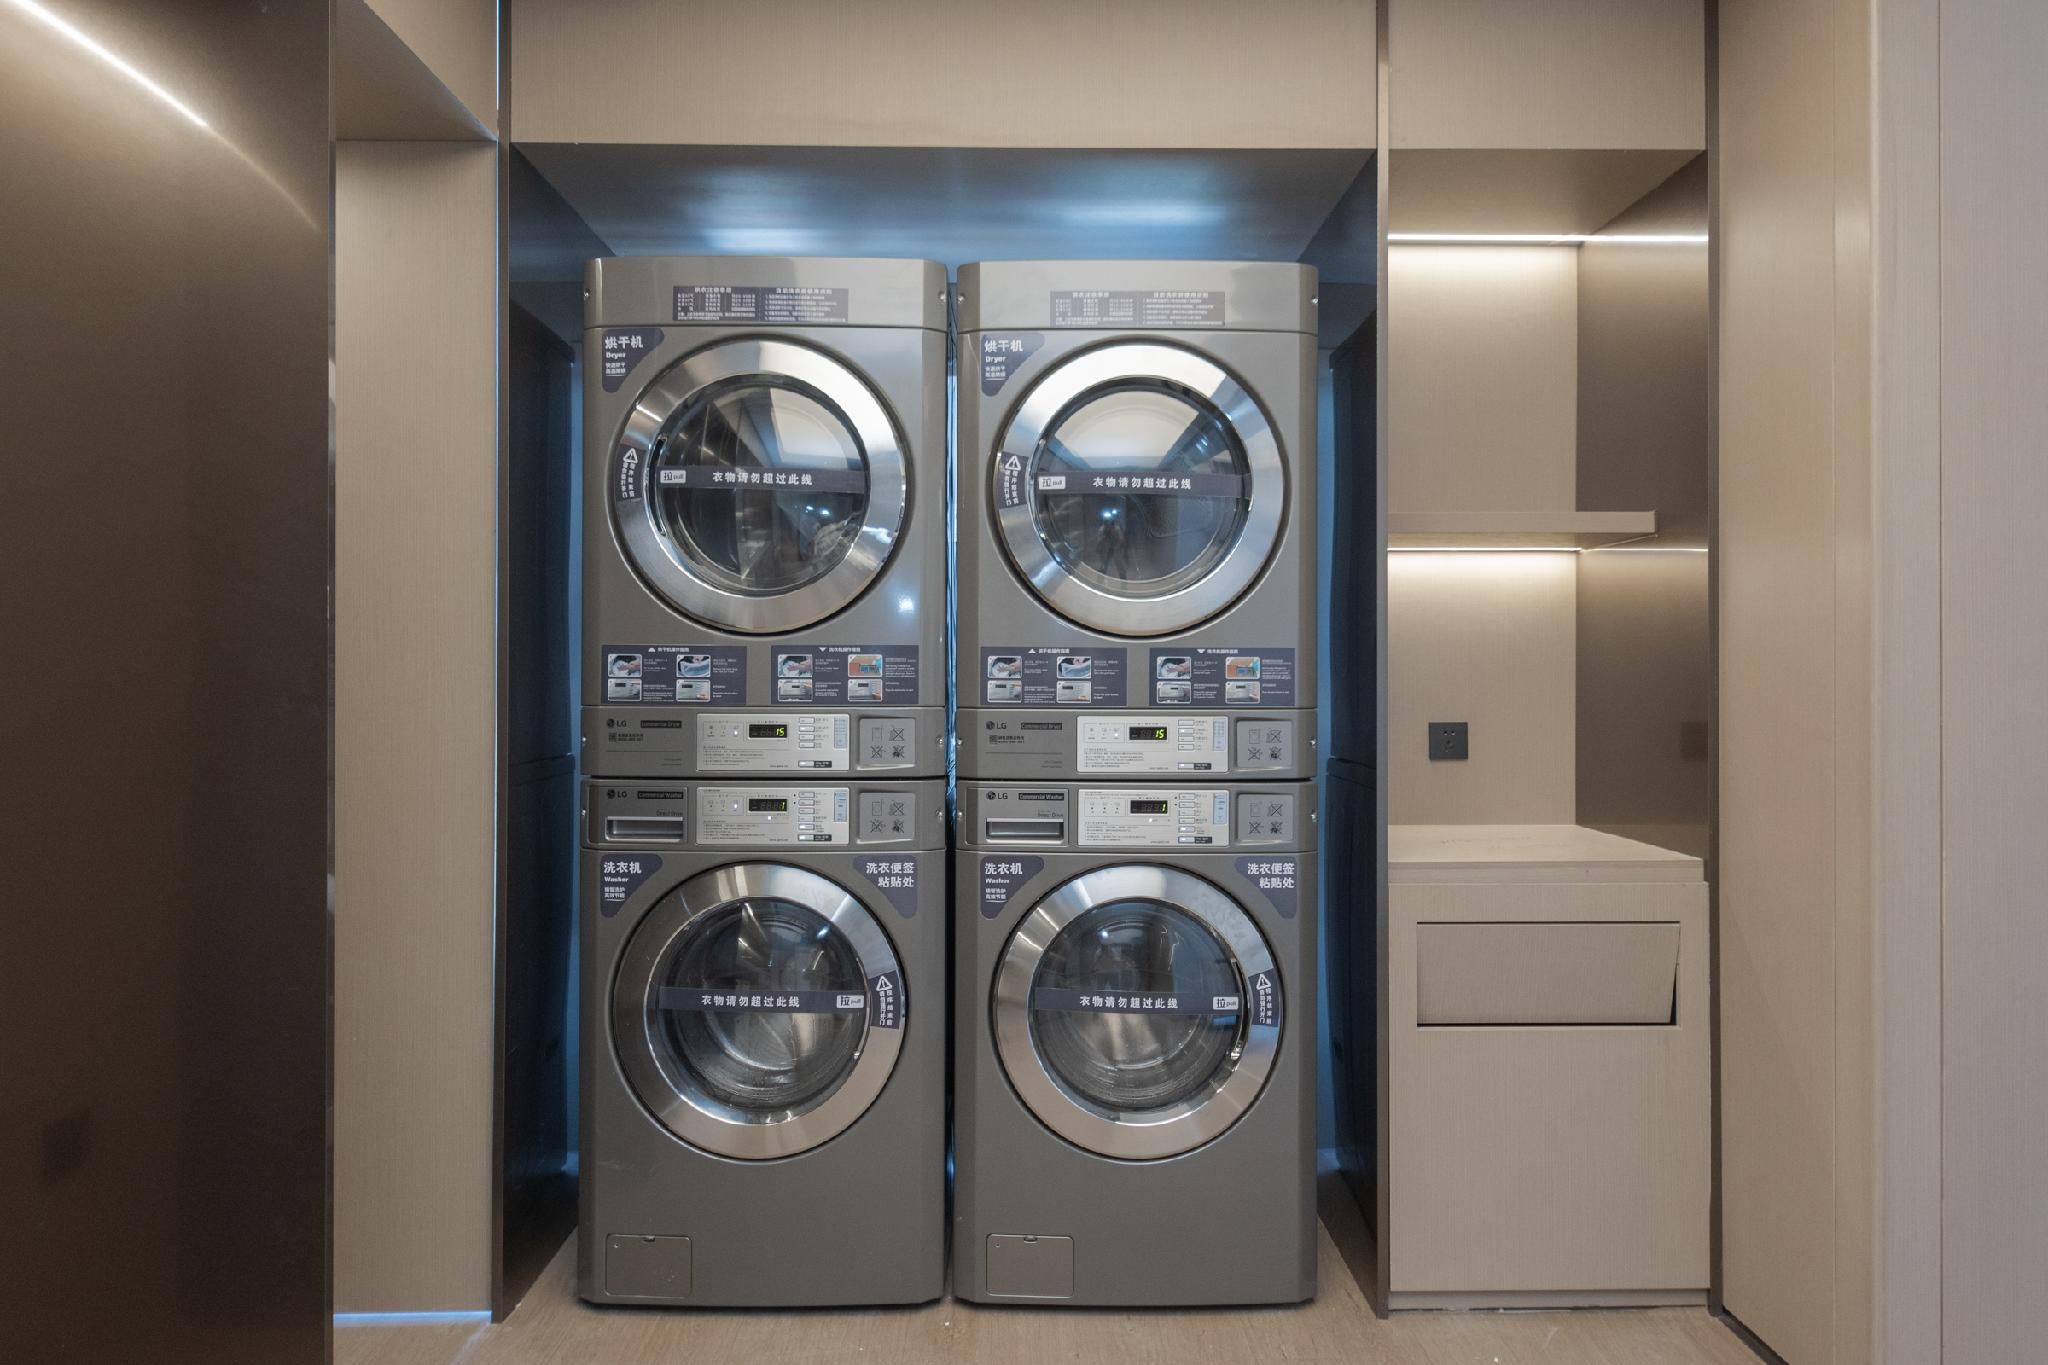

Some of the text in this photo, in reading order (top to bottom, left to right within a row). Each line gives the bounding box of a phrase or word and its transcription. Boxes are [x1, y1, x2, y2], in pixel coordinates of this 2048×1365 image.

[605, 335, 643, 349] 烘干机
[984, 339, 1023, 352] 烘干机
[712, 471, 813, 486] 衣物请勿超过此线
[1092, 476, 1192, 490] 衣物请勿超过此线
[775, 727, 785, 737] 15
[1155, 729, 1165, 738] 15
[603, 861, 642, 874] 洗衣机
[866, 862, 915, 874] 洗衣便签
[985, 862, 1023, 875] 洗衣机
[1247, 862, 1295, 875] 洗衣便签
[877, 876, 914, 888] 粘贴处
[1259, 877, 1295, 888] 粘贴处
[701, 994, 800, 1008] 衣物请勿超过此线
[840, 995, 850, 1006] 拉
[1080, 995, 1179, 1009] 衣物请勿超过此线
[1216, 997, 1226, 1008] 拉
